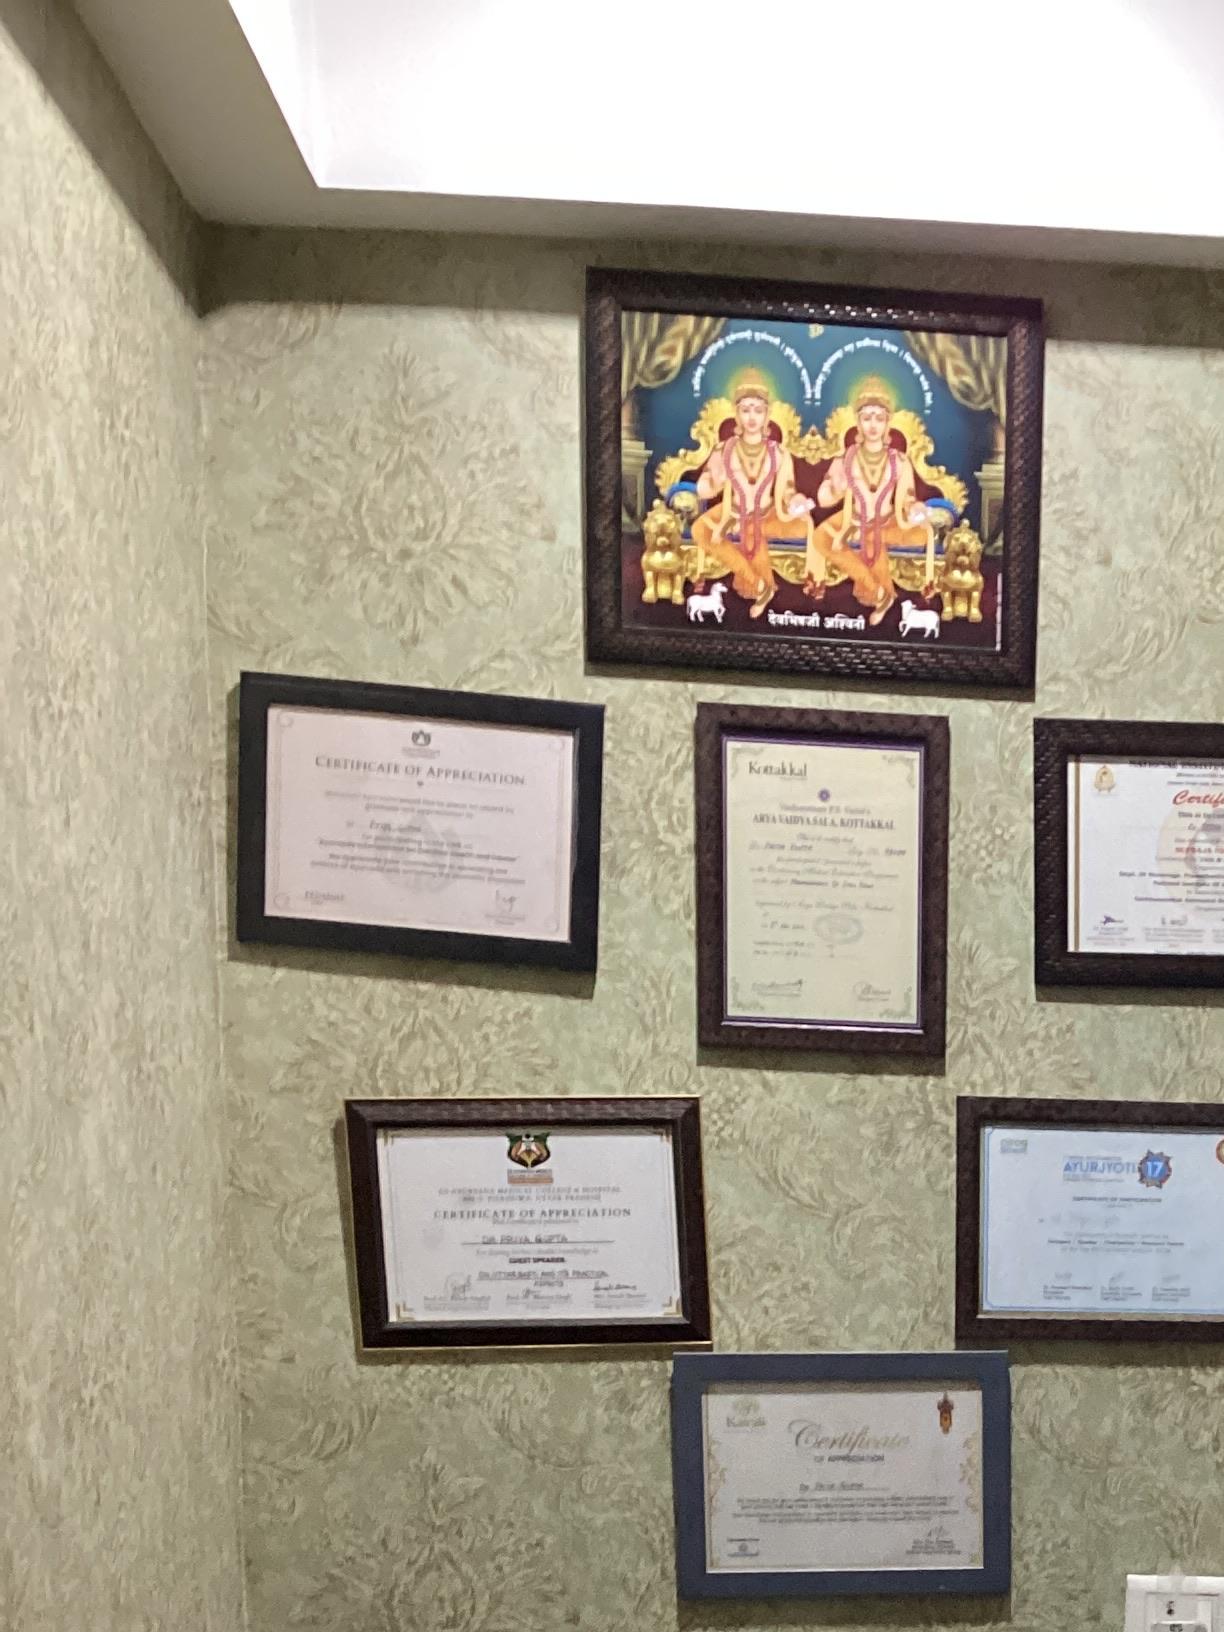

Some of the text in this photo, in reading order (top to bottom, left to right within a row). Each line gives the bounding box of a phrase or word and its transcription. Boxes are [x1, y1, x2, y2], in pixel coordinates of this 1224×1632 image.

[1063, 1160, 1164, 1178] AYURJYOTI 17
[520, 1208, 535, 1219] OF
